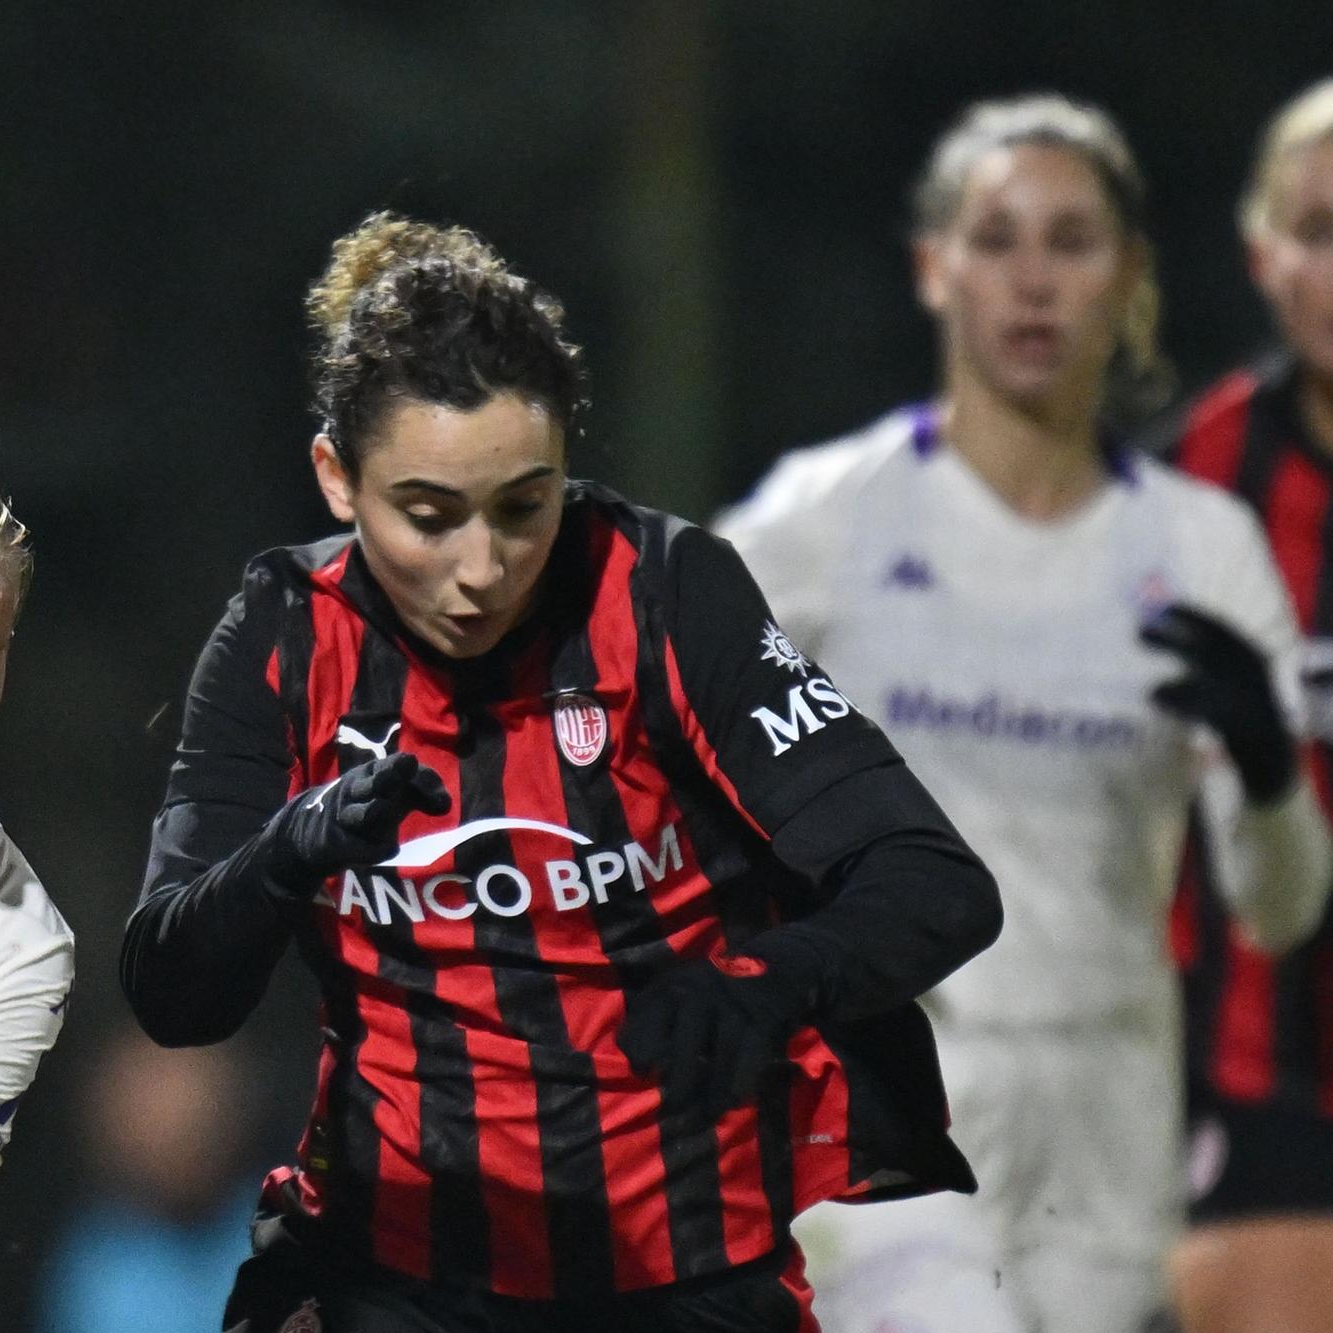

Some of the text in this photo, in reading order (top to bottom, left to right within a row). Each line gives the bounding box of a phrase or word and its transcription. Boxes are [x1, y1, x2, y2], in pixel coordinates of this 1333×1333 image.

[750, 678, 861, 757] MS
[313, 823, 684, 925] ANCO BPM
